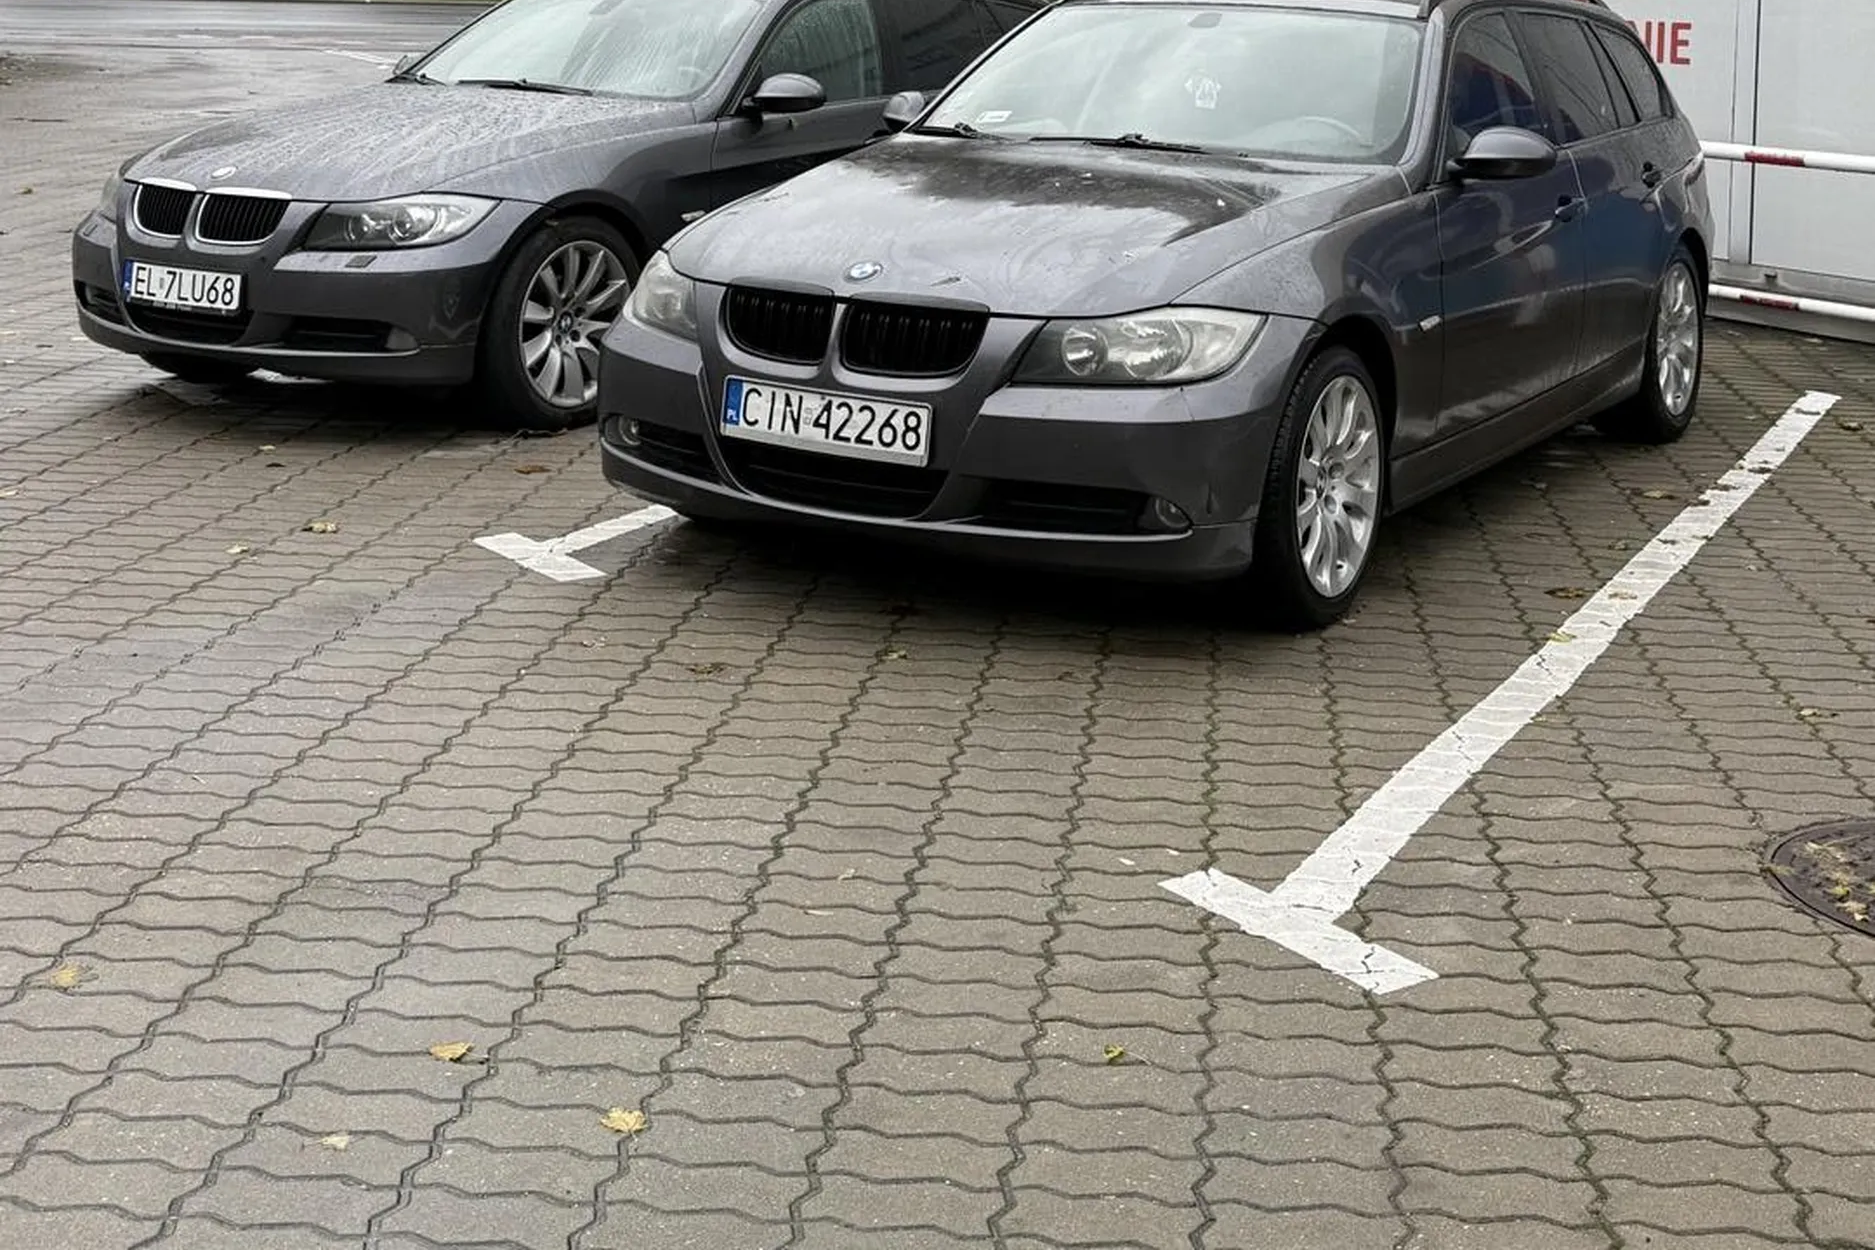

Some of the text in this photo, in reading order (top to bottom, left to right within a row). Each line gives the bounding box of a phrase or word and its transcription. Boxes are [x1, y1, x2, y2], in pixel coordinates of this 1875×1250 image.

[134, 266, 235, 306] EL 7LU68
[726, 408, 738, 421] PL
[742, 387, 923, 451] CIN 42268
